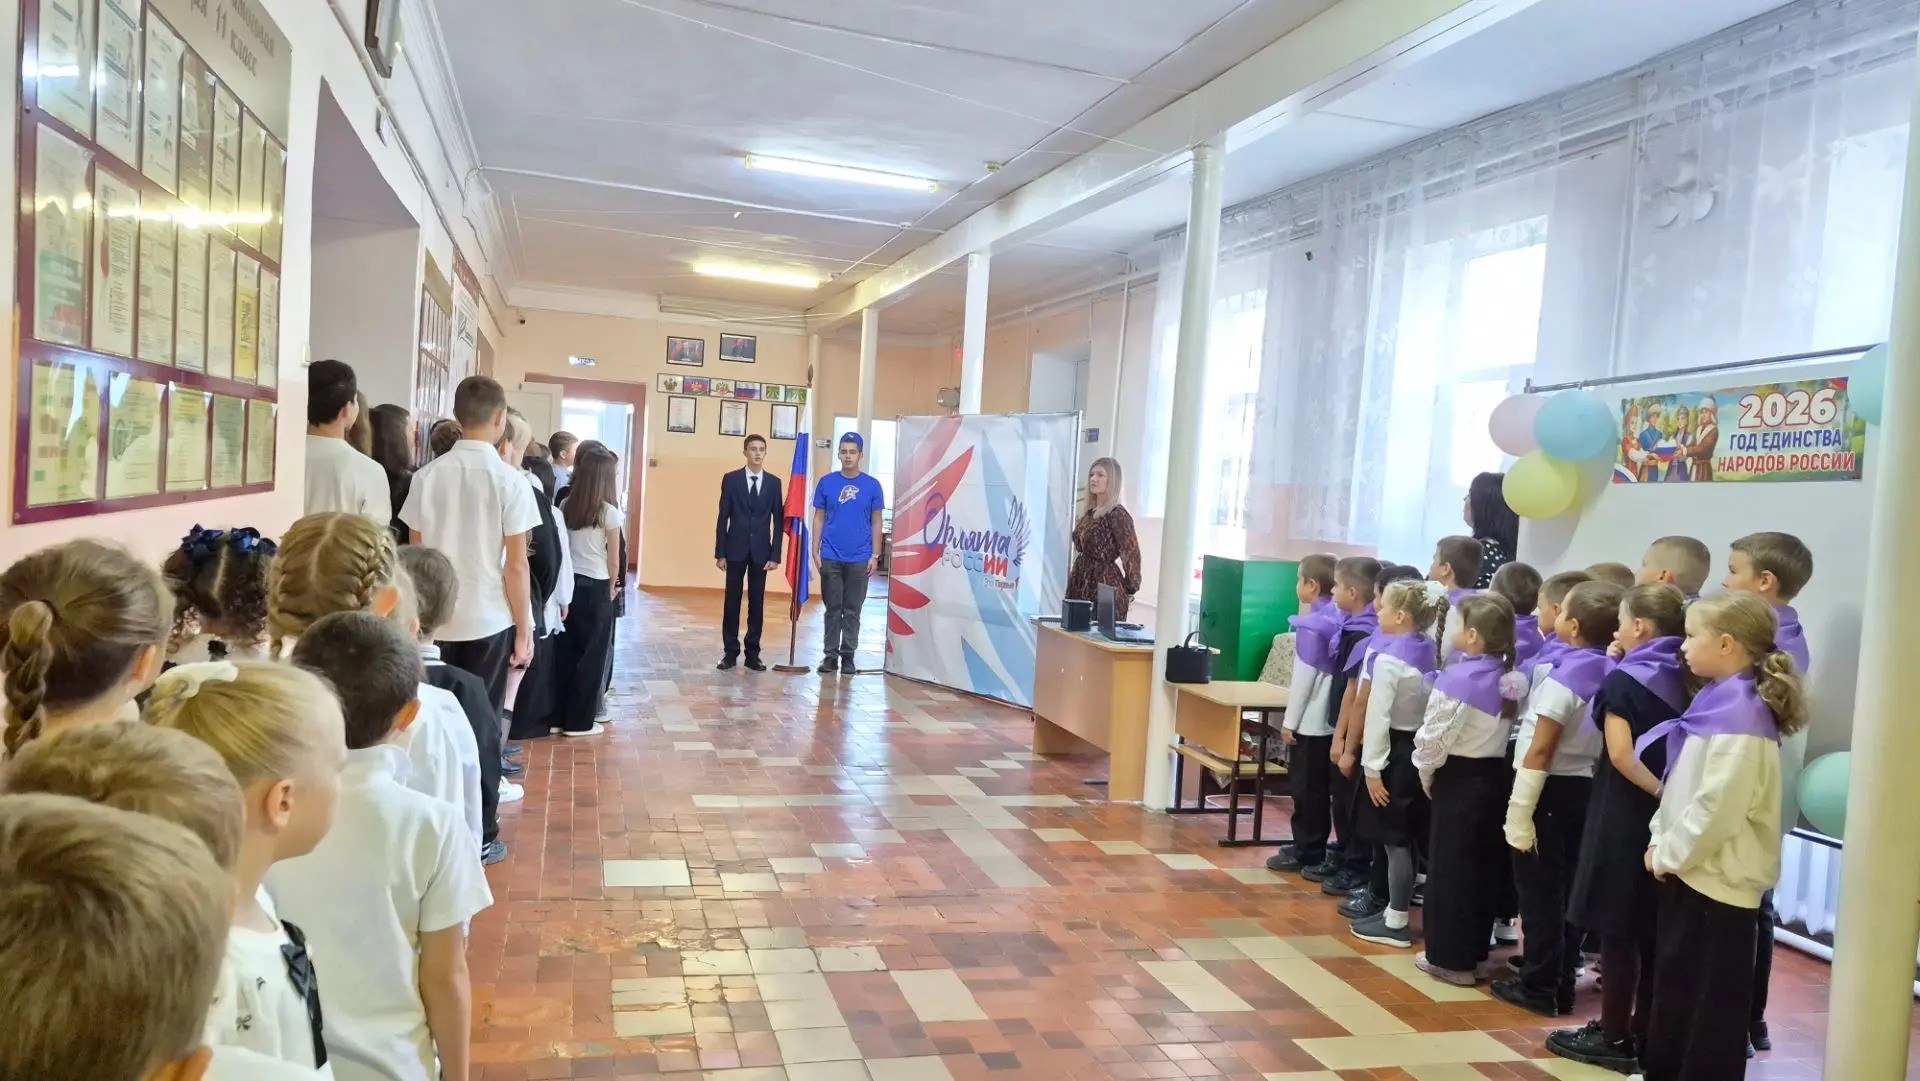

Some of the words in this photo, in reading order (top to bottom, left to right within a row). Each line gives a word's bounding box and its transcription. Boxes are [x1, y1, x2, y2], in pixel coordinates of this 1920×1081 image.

[216, 2, 227, 40] 11
[230, 29, 257, 77] класс
[1738, 389, 1838, 429] 2026
[1730, 432, 1758, 451] ГОД
[1761, 429, 1842, 451] ЕДИНСТВА
[1718, 454, 1786, 474] НАРОДОВ
[1789, 450, 1856, 472] РОССИИ
[923, 492, 1011, 558] Орлята
